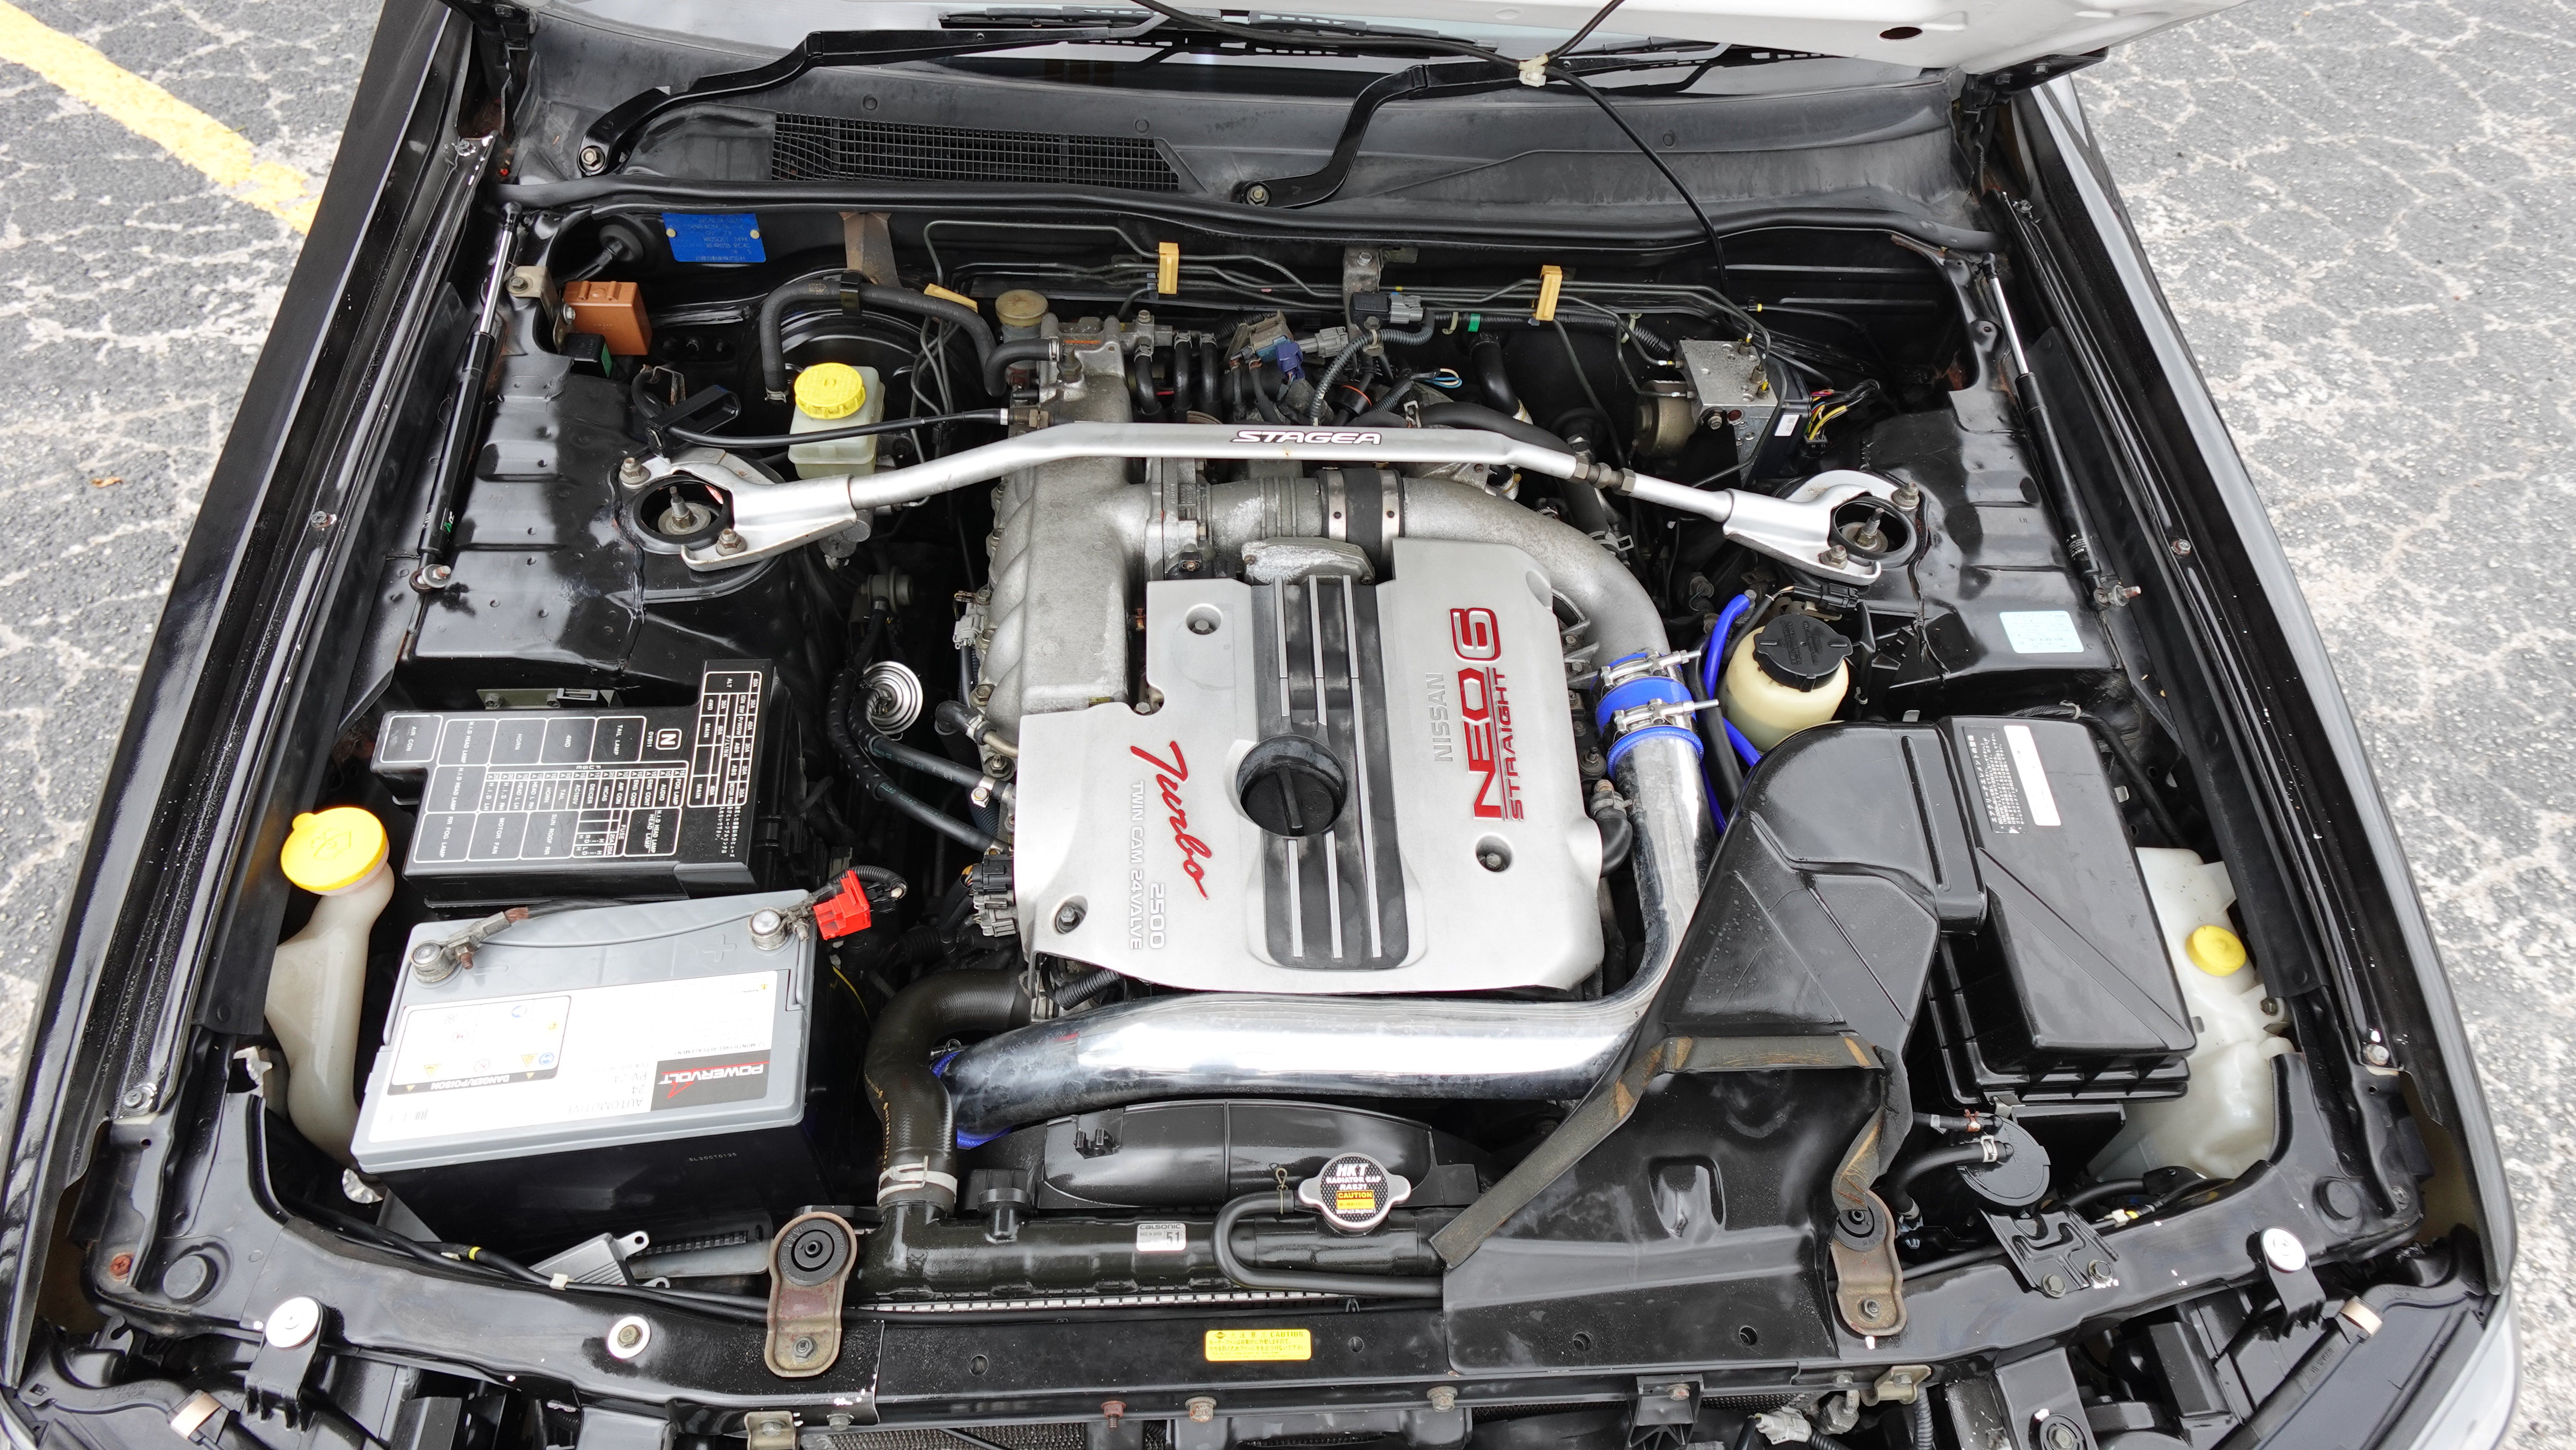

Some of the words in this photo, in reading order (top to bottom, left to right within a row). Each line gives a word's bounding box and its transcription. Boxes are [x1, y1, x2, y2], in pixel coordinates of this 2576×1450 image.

[1230, 430, 1382, 444] STAGEA
[739, 705, 745, 714] SW
[1425, 673, 1453, 762] NISSAN
[1492, 667, 1524, 821] STRAIGHT
[544, 787, 552, 803] HORN
[572, 784, 581, 805] AC100V
[587, 784, 596, 804] DEICER
[1132, 780, 1144, 821] TWIN
[447, 816, 453, 824] RR
[495, 817, 505, 839] MOTOR
[1130, 741, 1212, 900] Turbo
[443, 827, 451, 839] FOG
[547, 828, 555, 844] ROOF
[544, 846, 551, 855] RR
[1131, 826, 1143, 863] CAM
[1130, 870, 1143, 949] 24VALVE
[1149, 884, 1165, 949] 2500
[674, 1047, 717, 1055] REPLACEMENT
[632, 1071, 647, 1081] PV
[657, 1063, 765, 1085] POWERVOLT
[430, 1075, 511, 1090] DANGER/POISON
[1336, 1163, 1368, 1176] HKT
[1167, 1231, 1179, 1246] 51
